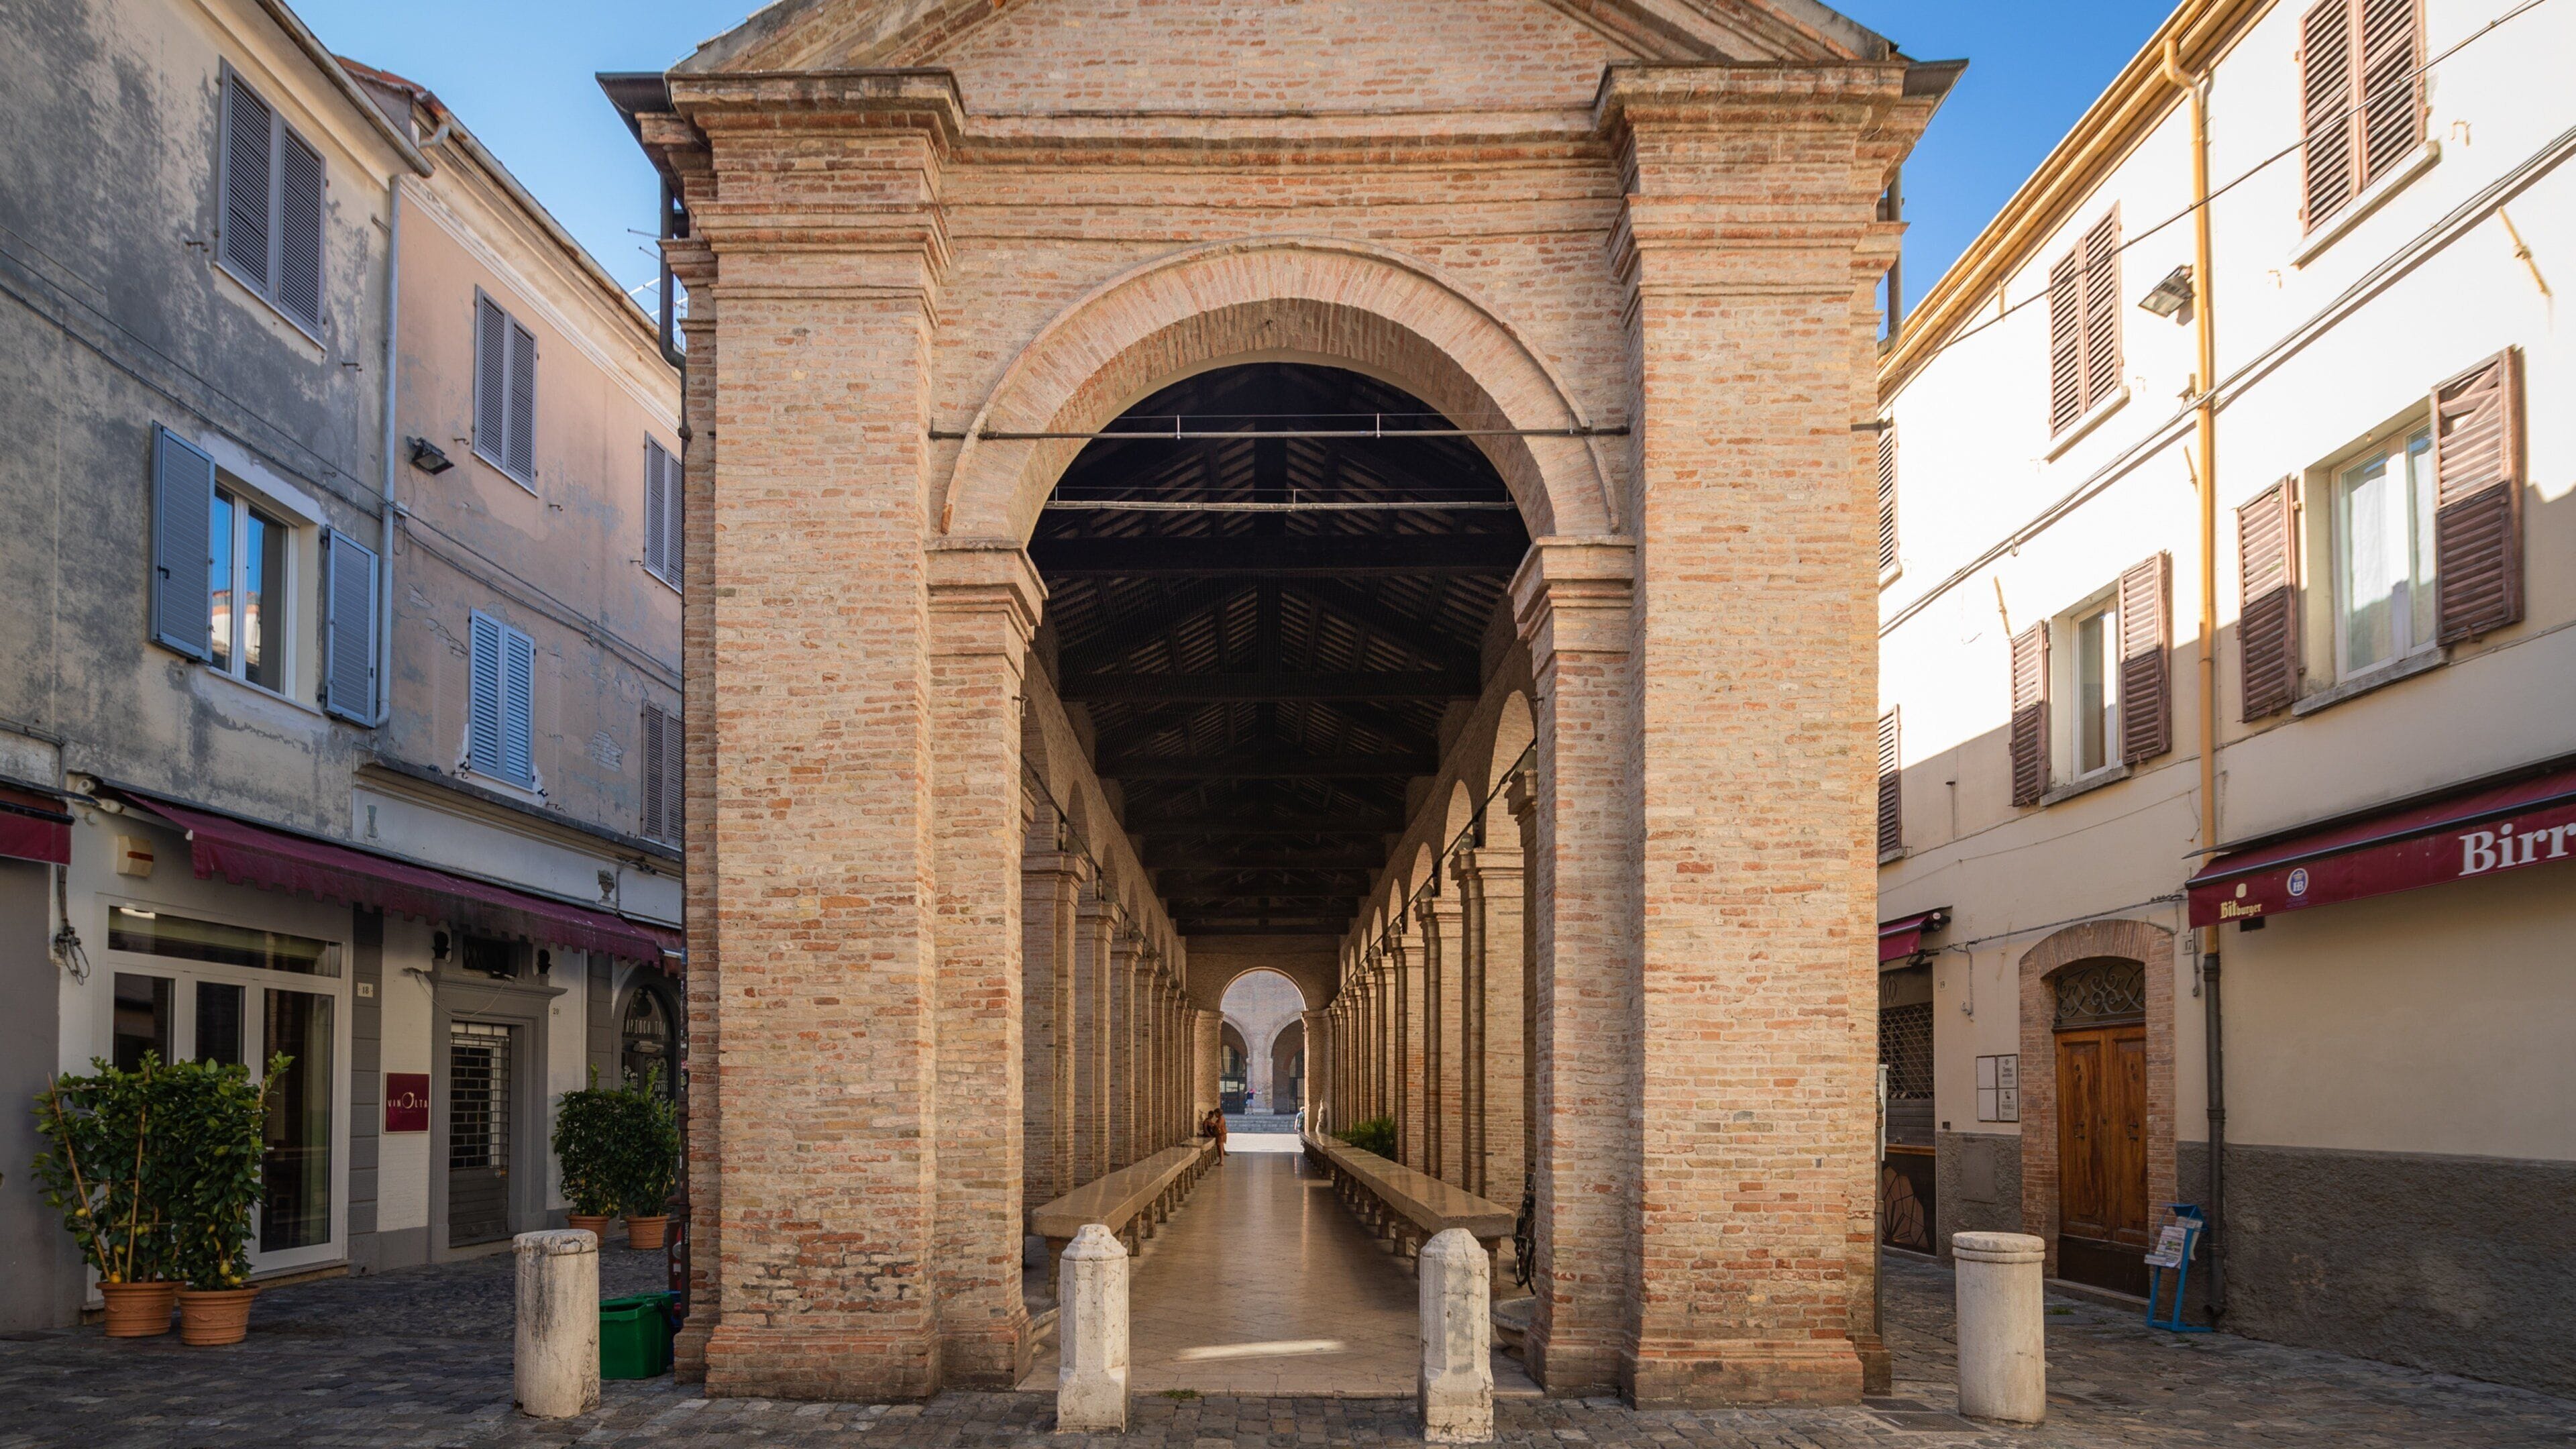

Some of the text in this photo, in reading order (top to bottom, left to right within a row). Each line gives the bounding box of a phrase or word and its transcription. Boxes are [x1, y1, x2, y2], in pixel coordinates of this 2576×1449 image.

[2458, 822, 2576, 876] Birr
[2220, 900, 2262, 919] Bitburger
[2185, 939, 2192, 950] 17
[362, 986, 369, 994] 18
[387, 1091, 427, 1109] VINOLTA
